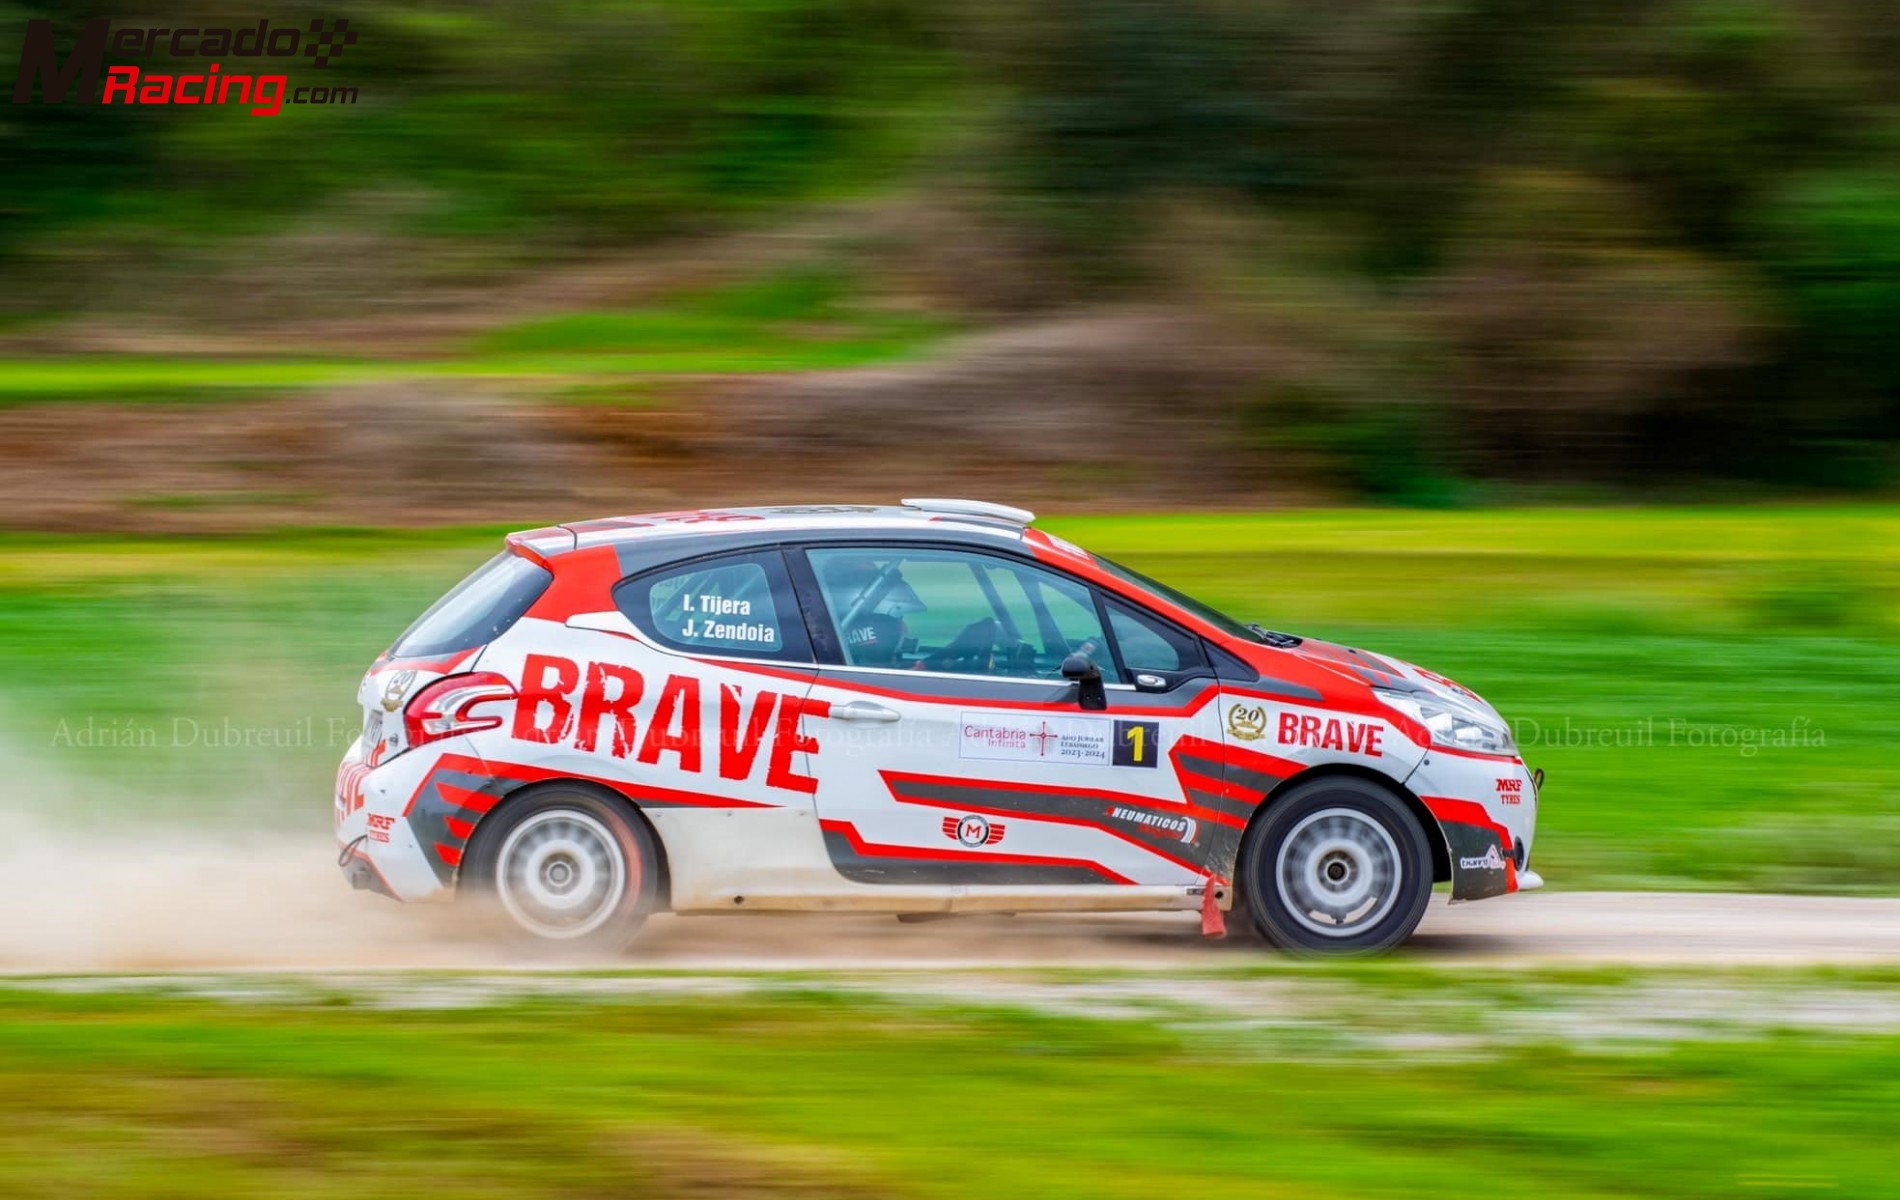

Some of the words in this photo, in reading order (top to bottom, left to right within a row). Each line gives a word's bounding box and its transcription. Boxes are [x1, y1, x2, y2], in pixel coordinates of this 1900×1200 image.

[700, 595, 751, 616] Tijera
[681, 619, 698, 638] J.
[703, 620, 776, 643] Zendoia
[511, 653, 832, 795] BRAVE
[1235, 707, 1260, 722] 20
[964, 725, 1026, 740] Cantabria
[1277, 712, 1384, 758] BRAVE
[1127, 726, 1144, 762] 1
[1496, 779, 1522, 791] MRF
[1501, 794, 1521, 805] TYRES
[1112, 807, 1187, 832] NEUMATICOS
